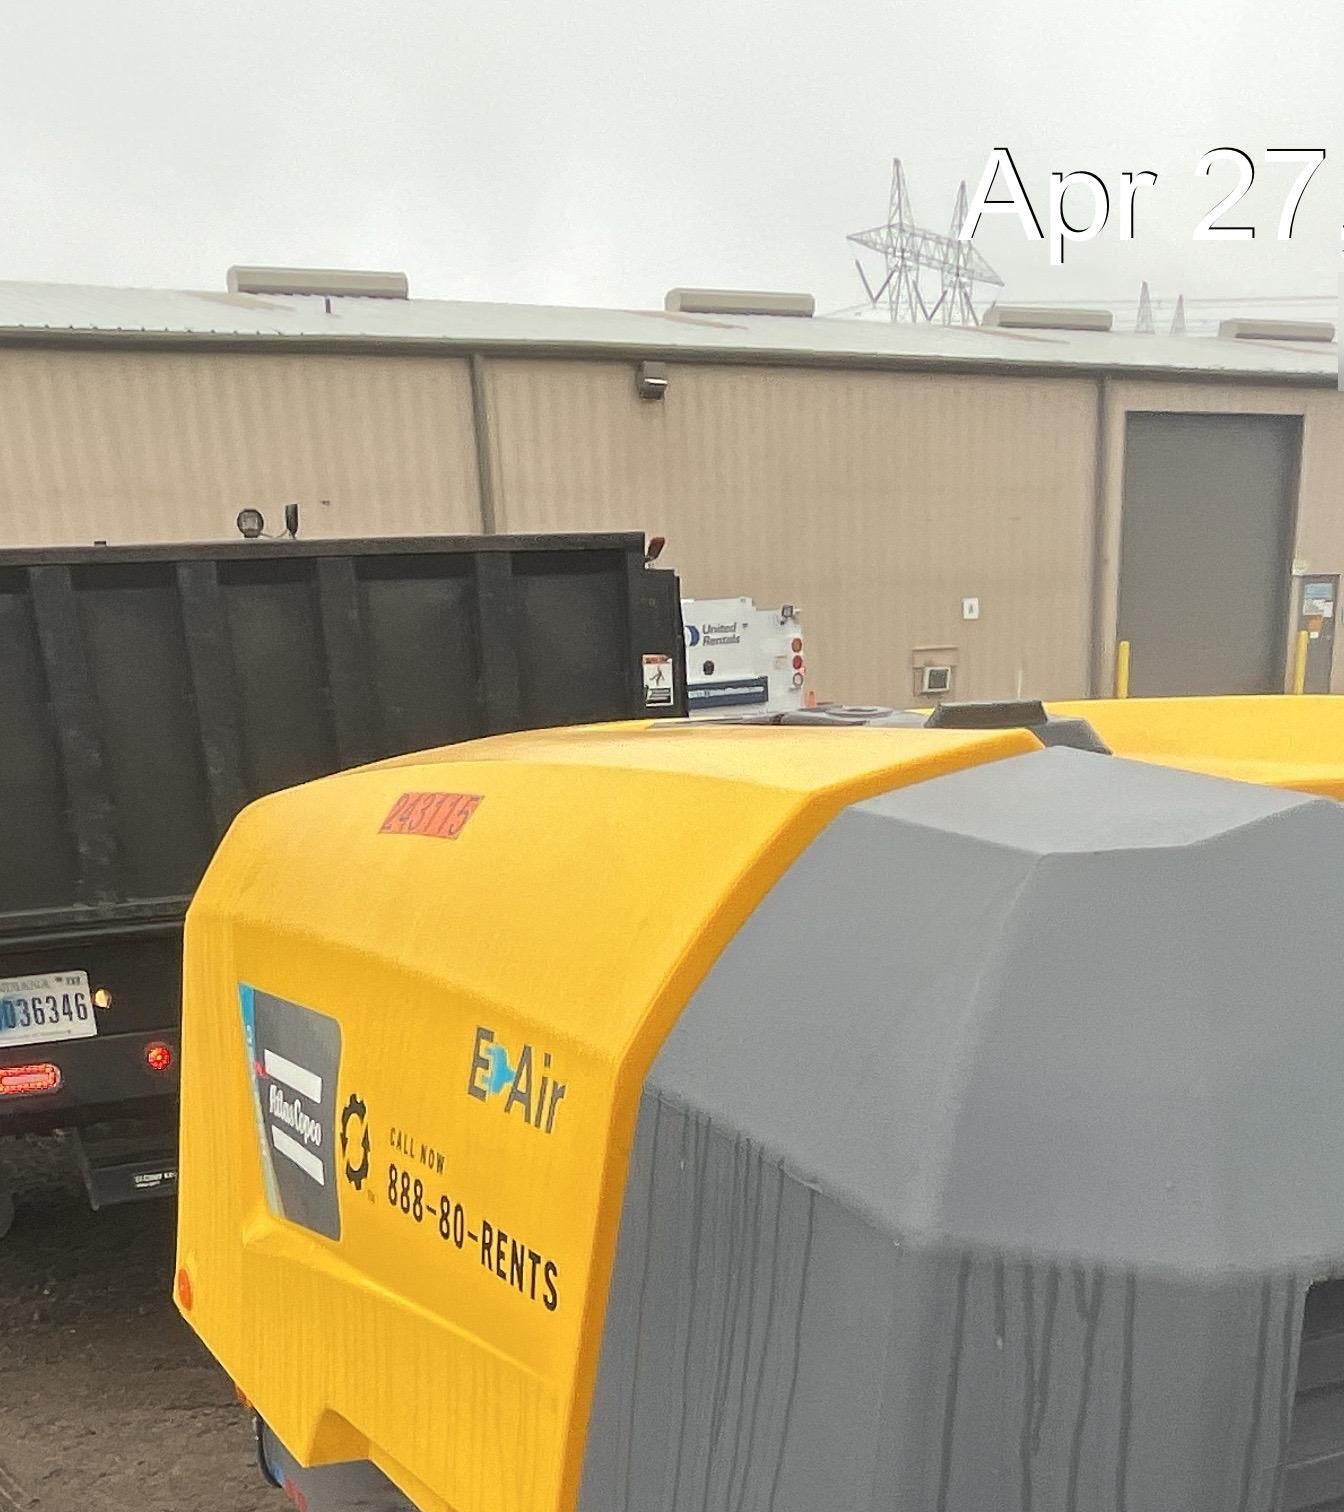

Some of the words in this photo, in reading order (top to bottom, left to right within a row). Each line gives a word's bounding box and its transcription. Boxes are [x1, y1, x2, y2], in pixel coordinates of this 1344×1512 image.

[702, 622, 737, 635] United
[703, 635, 741, 647] Rentals
[382, 792, 482, 837] 243115
[389, 1127, 415, 1159] CALL
[419, 1143, 445, 1176] NOW
[388, 1163, 559, 1312] 888-80-RENTS
